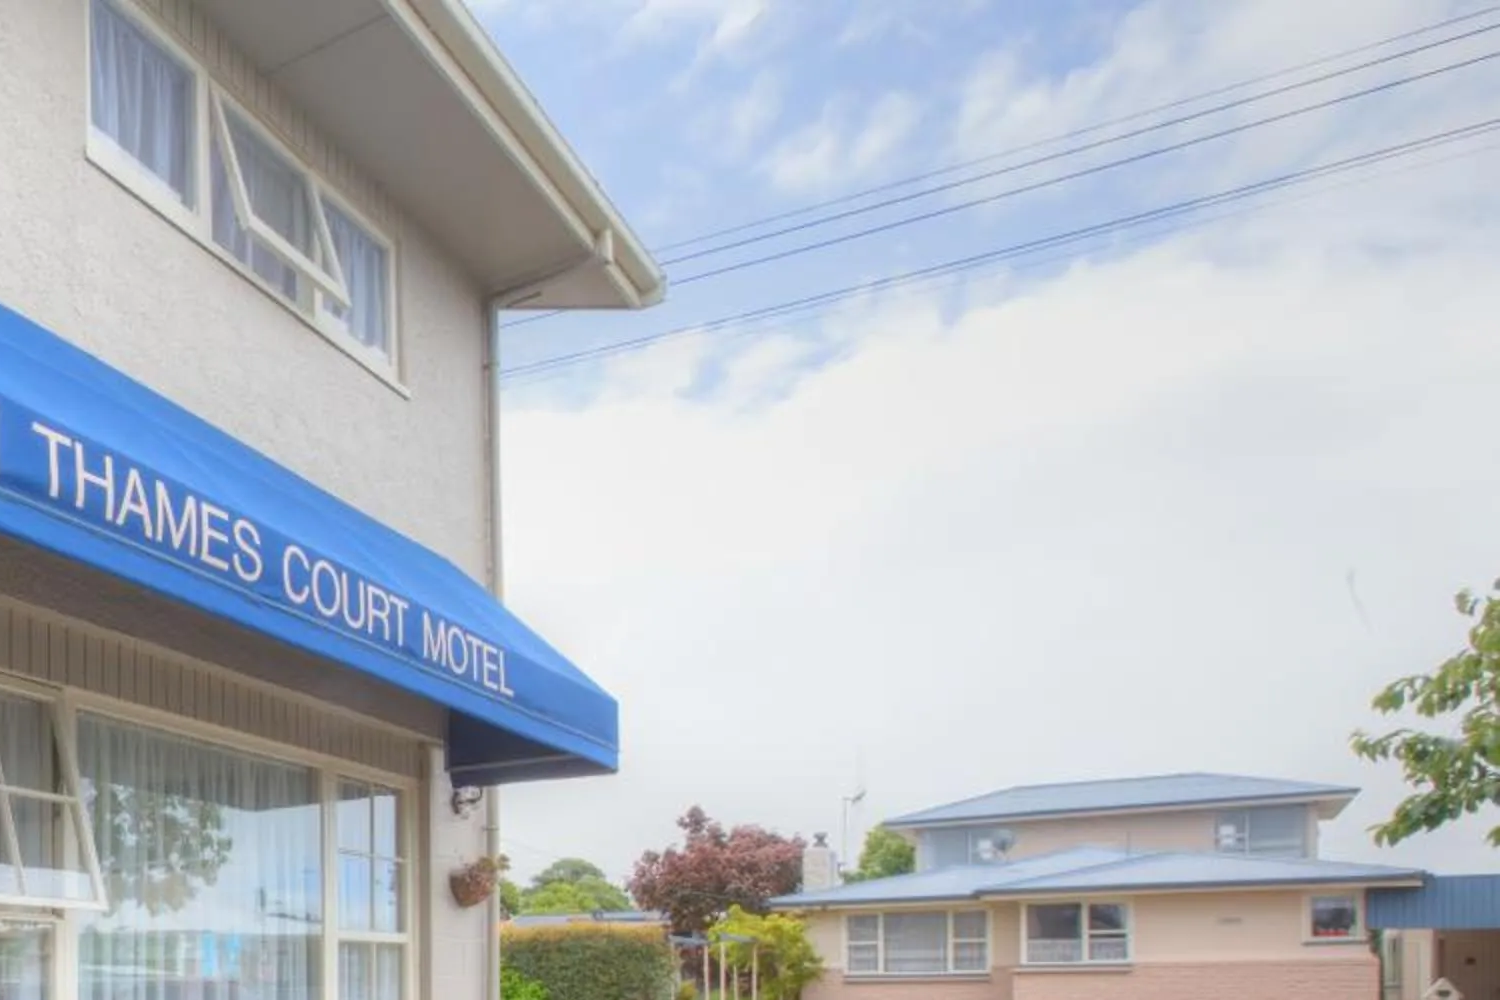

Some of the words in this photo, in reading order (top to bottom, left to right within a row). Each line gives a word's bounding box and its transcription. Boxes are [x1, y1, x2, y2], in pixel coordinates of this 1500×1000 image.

[32, 421, 263, 583] THAMES
[283, 544, 409, 648] COURT
[422, 610, 515, 698] MOTEL
